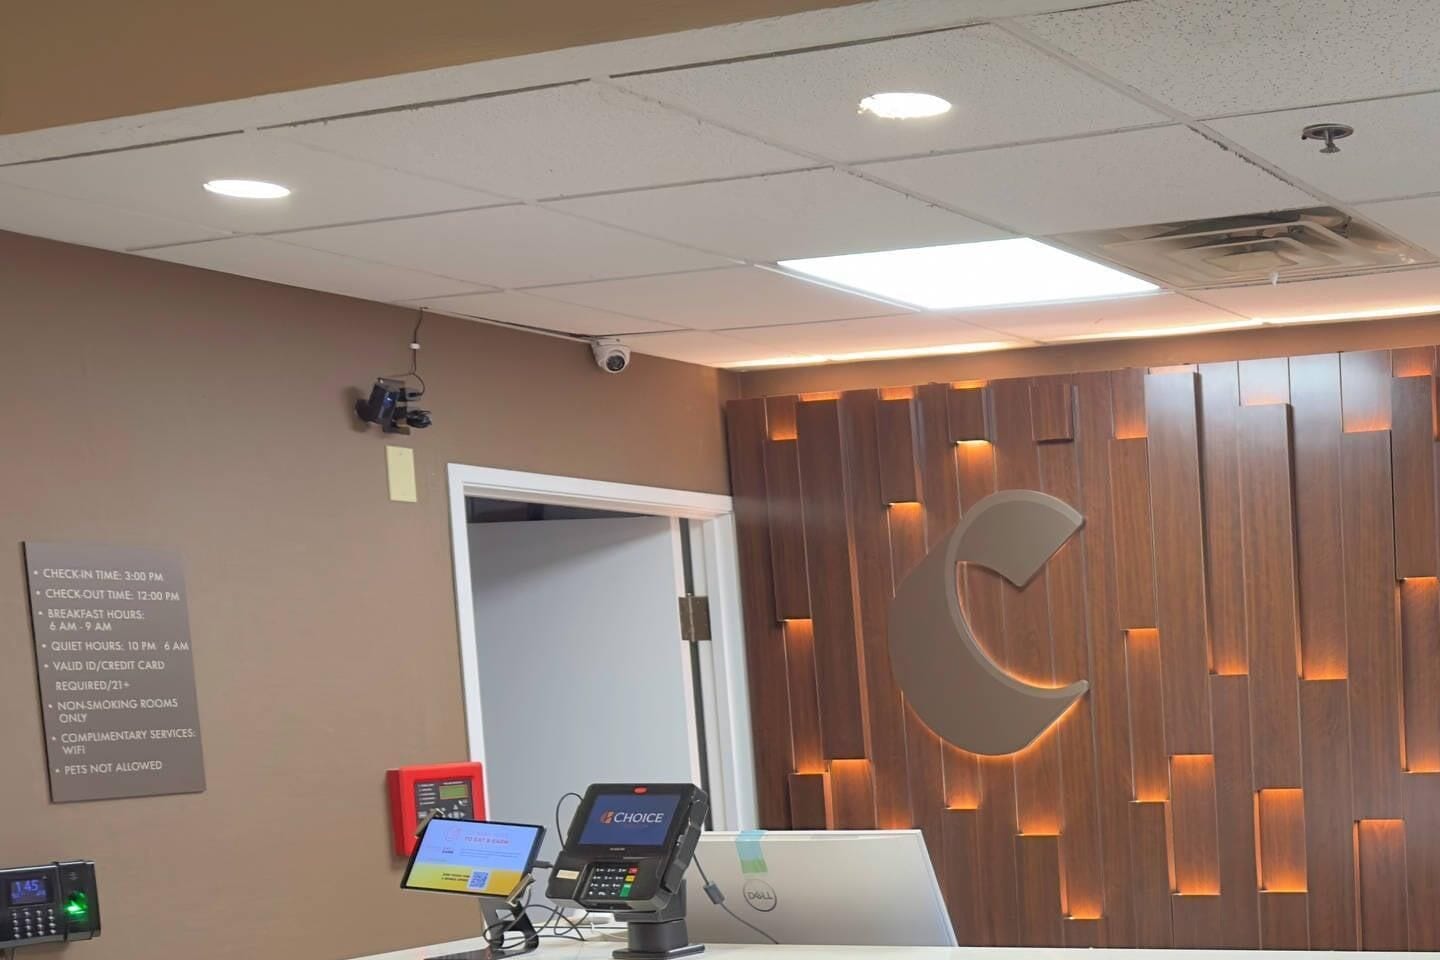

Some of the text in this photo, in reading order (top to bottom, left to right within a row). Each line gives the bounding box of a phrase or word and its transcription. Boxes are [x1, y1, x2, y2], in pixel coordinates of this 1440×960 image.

[43, 568, 164, 581] CHECK-IN TIME: 3:00 PM
[45, 588, 180, 601] CHECK-OUT TIME: 12:00 PM
[48, 608, 145, 620] BREAKFAST HOURS:
[49, 622, 57, 631] 6
[59, 622, 77, 631] AM
[85, 622, 92, 631] 9
[94, 622, 112, 631] AM
[51, 641, 82, 651] QUIET
[85, 641, 125, 651] HOURS:
[128, 641, 139, 650] 10
[141, 641, 157, 650] PM
[164, 641, 170, 650] 6
[172, 641, 189, 650] AM
[53, 660, 165, 672] VALID ID/CREDIT CARD
[55, 680, 130, 691] REQUIRED/21+
[57, 699, 178, 710] NON-SMOKING ROOMS
[59, 713, 87, 723] ONLY
[61, 730, 147, 743] COMPLIMENTARY
[65, 760, 162, 774] PETS NOT ALLOWED
[614, 812, 664, 823] CHOICE
